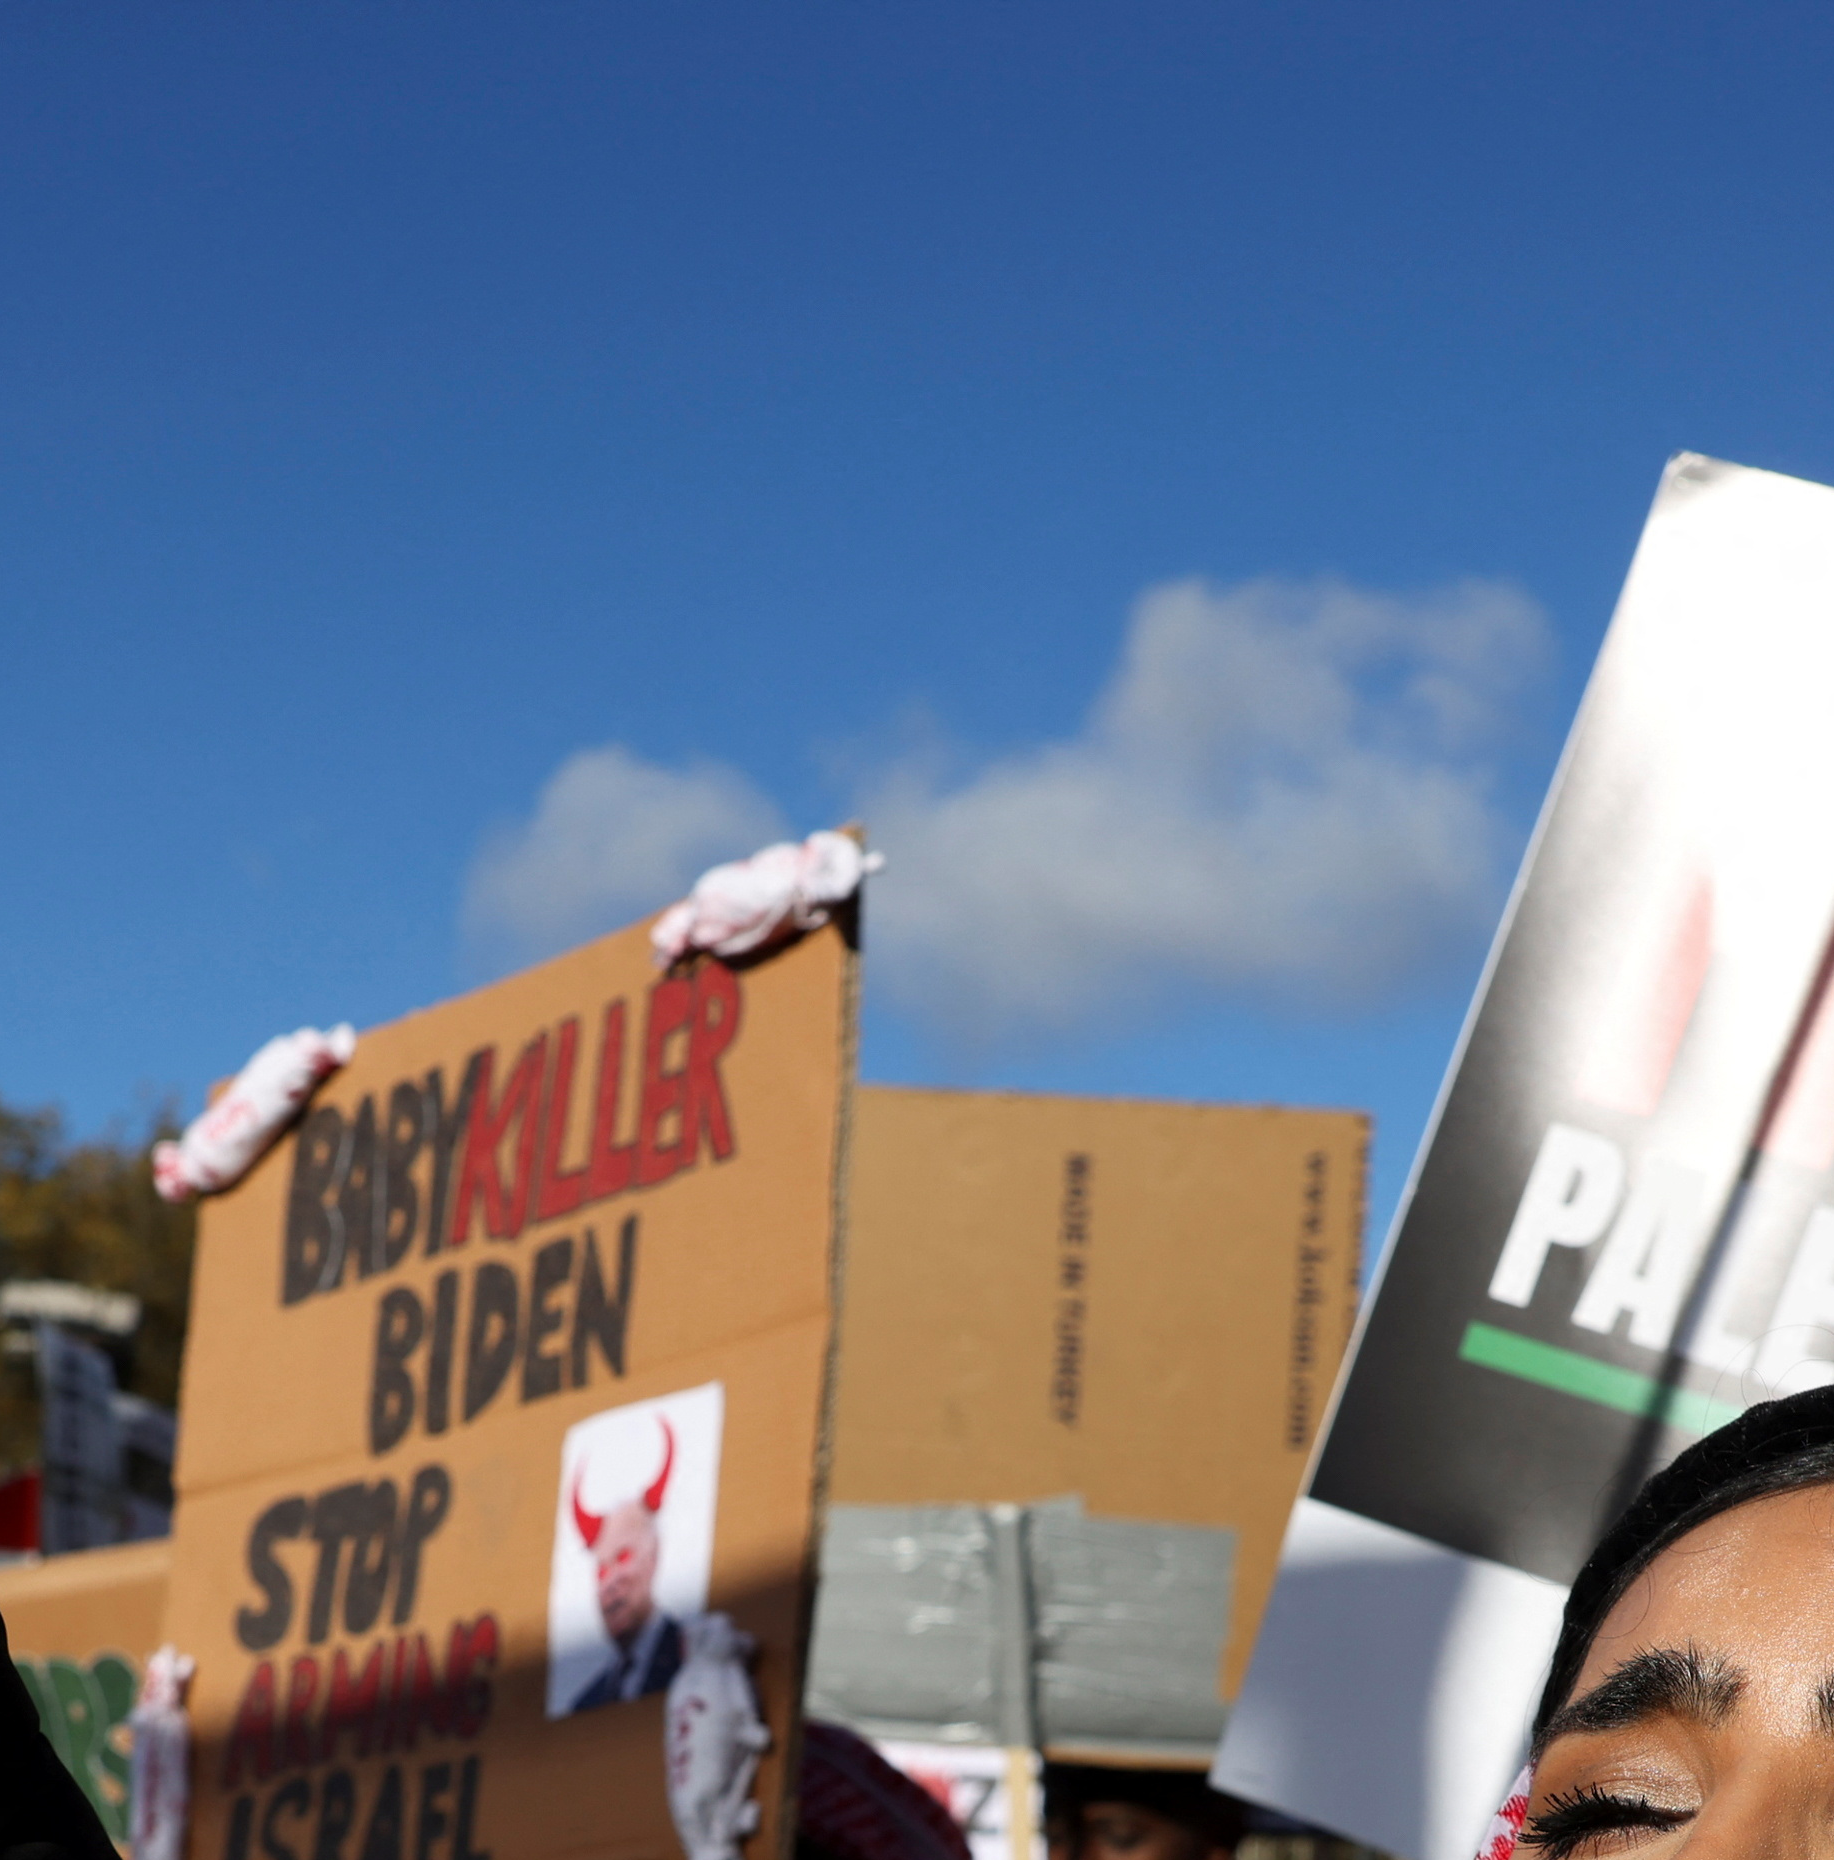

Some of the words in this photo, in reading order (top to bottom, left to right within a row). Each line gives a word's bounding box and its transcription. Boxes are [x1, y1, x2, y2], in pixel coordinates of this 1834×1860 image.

[372, 1213, 639, 1456] BIDEN
[236, 1463, 450, 1651] STOP
[222, 1613, 499, 1788] ARMING
